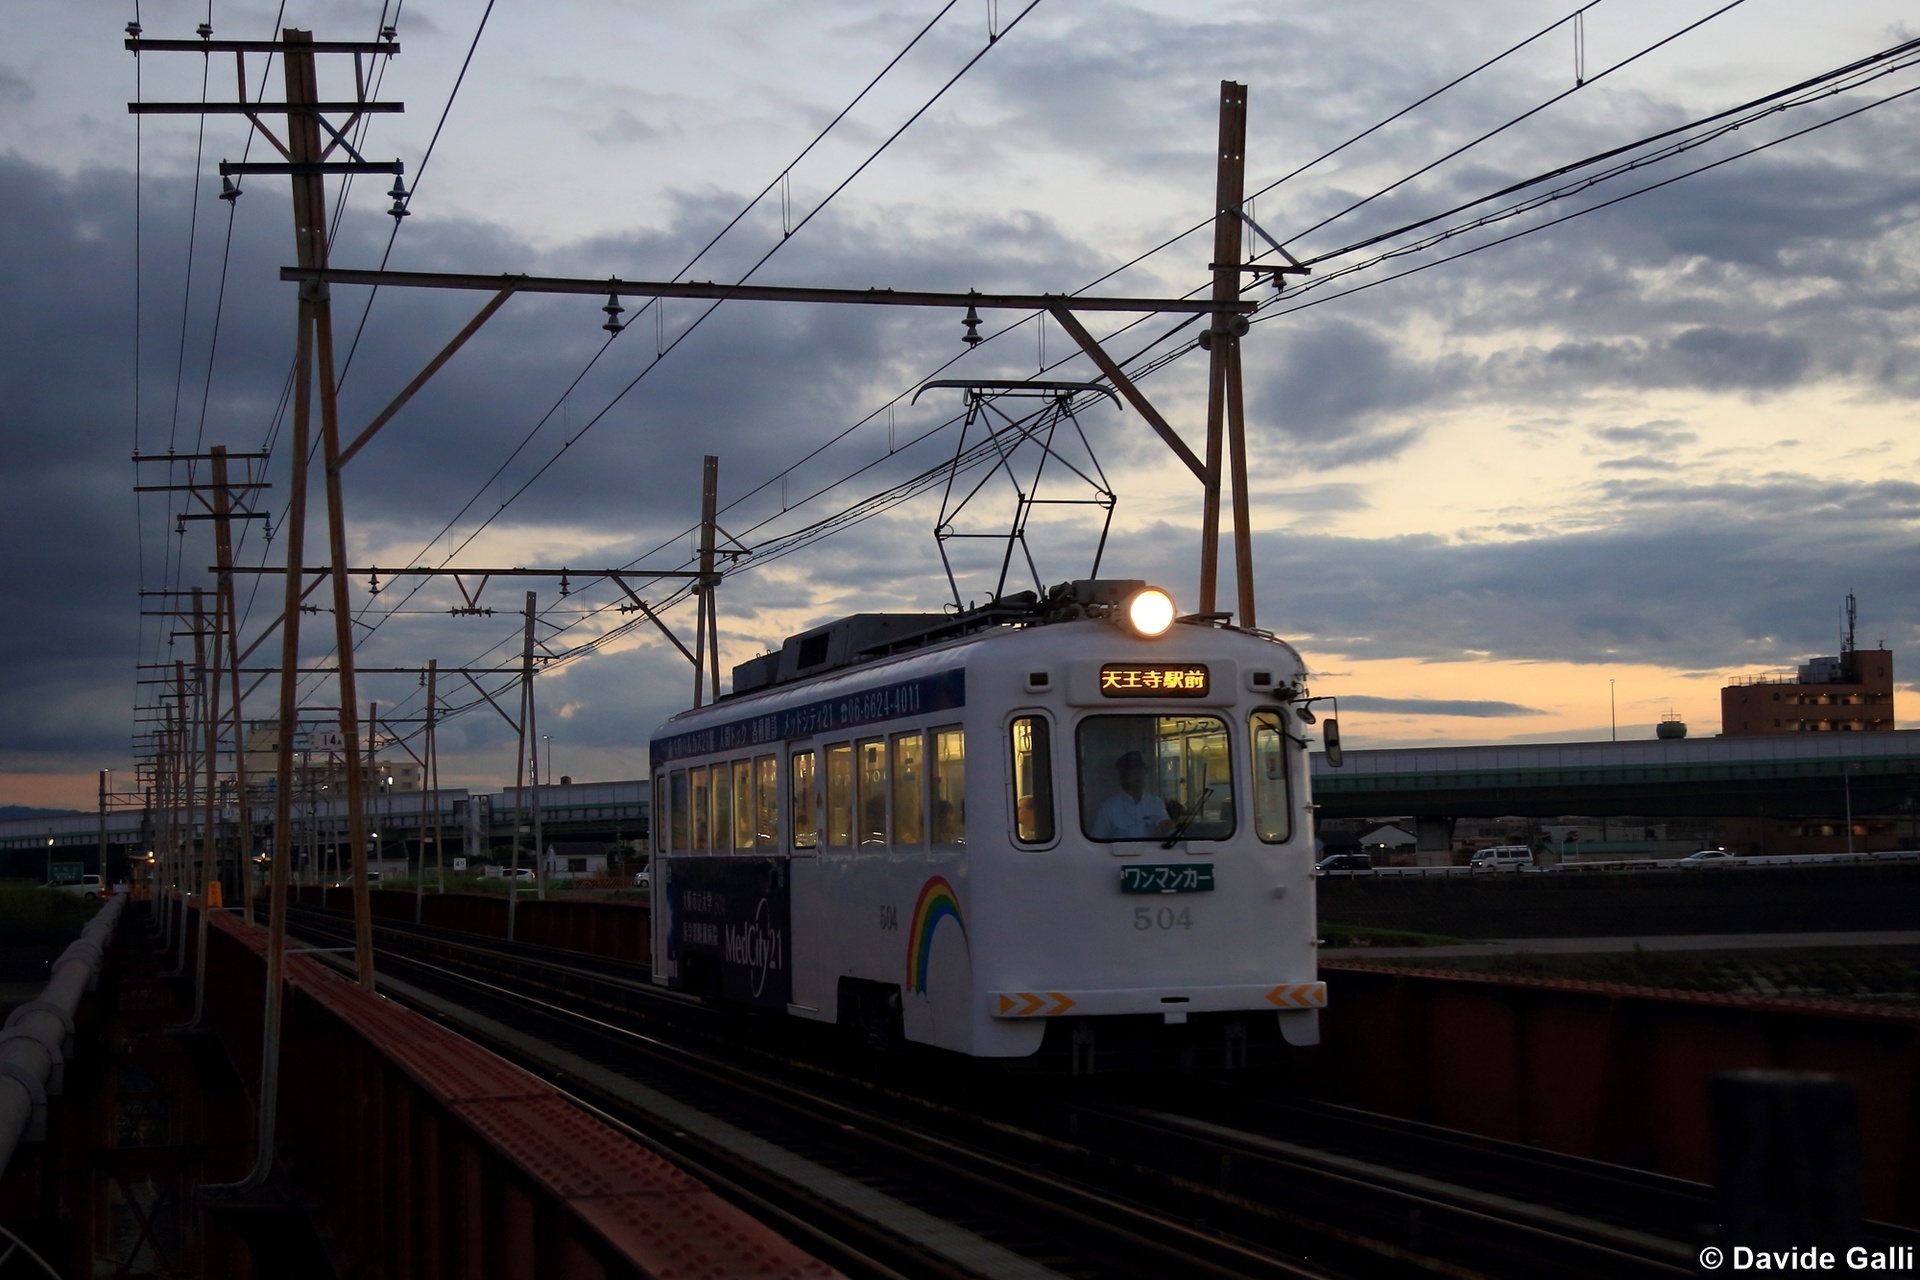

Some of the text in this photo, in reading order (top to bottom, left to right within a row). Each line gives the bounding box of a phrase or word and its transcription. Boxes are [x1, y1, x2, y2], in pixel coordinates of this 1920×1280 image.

[1101, 670, 1205, 689] 天王寺駅前
[783, 703, 833, 736] メッドシティ21
[1124, 866, 1212, 889] ワンマンカー
[880, 905, 898, 931] 504
[1134, 906, 1193, 931] 504
[725, 921, 782, 970] MedCity21
